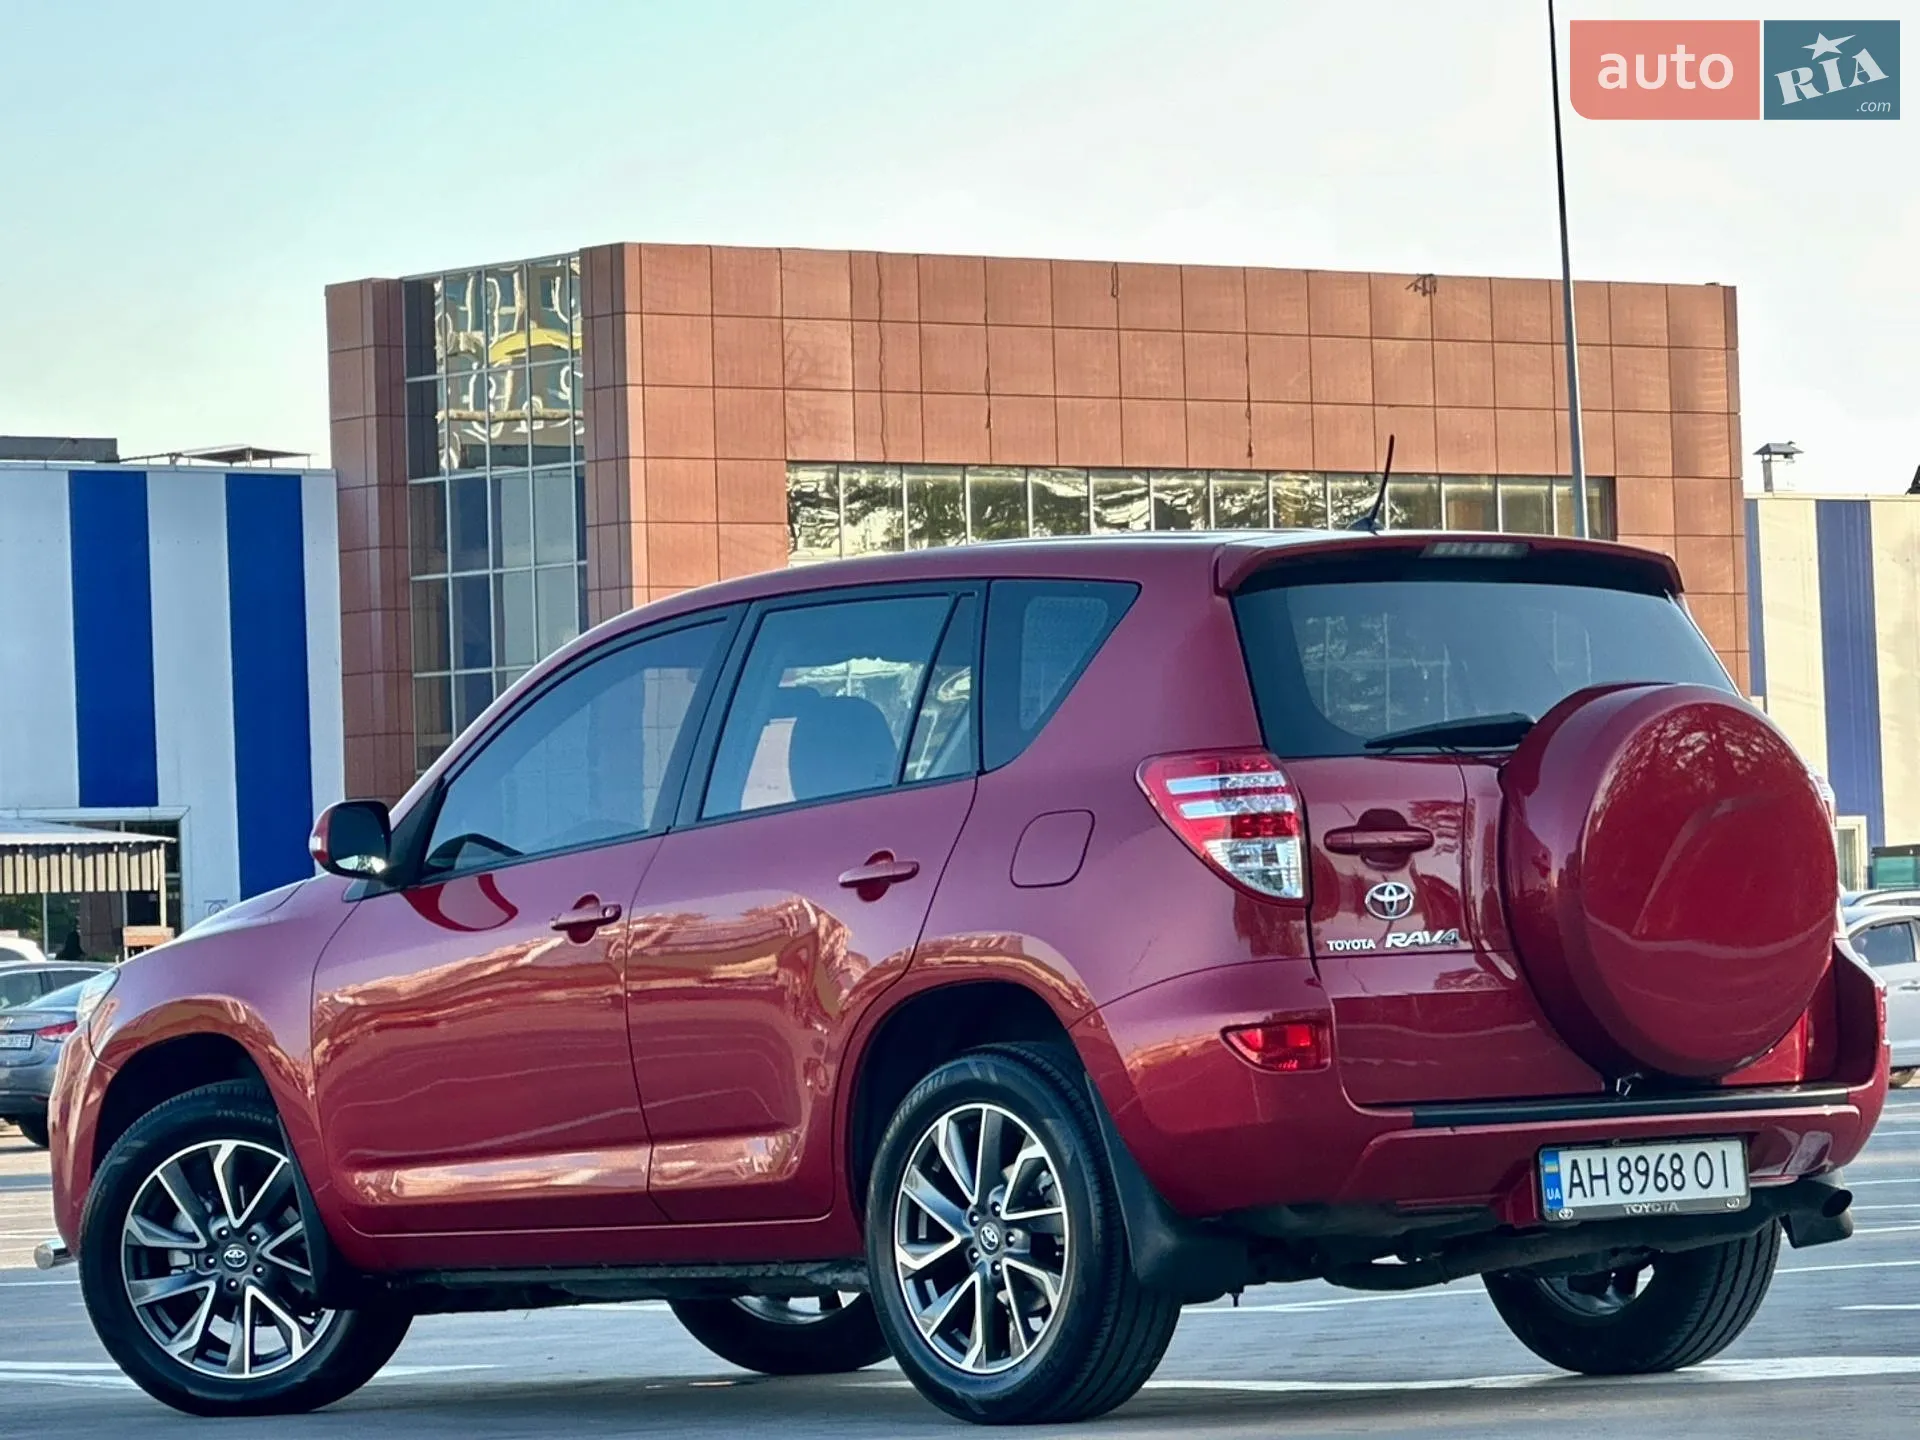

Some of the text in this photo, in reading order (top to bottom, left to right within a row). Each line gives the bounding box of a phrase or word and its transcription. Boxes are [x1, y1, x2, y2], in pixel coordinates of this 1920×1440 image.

[1326, 928, 1460, 951] TOYOTA RAV4
[1568, 1156, 1610, 1199] AH
[1617, 1153, 1686, 1195] 8968
[1546, 1188, 1562, 1201] UA
[1623, 1201, 1680, 1215] TOYOTA
